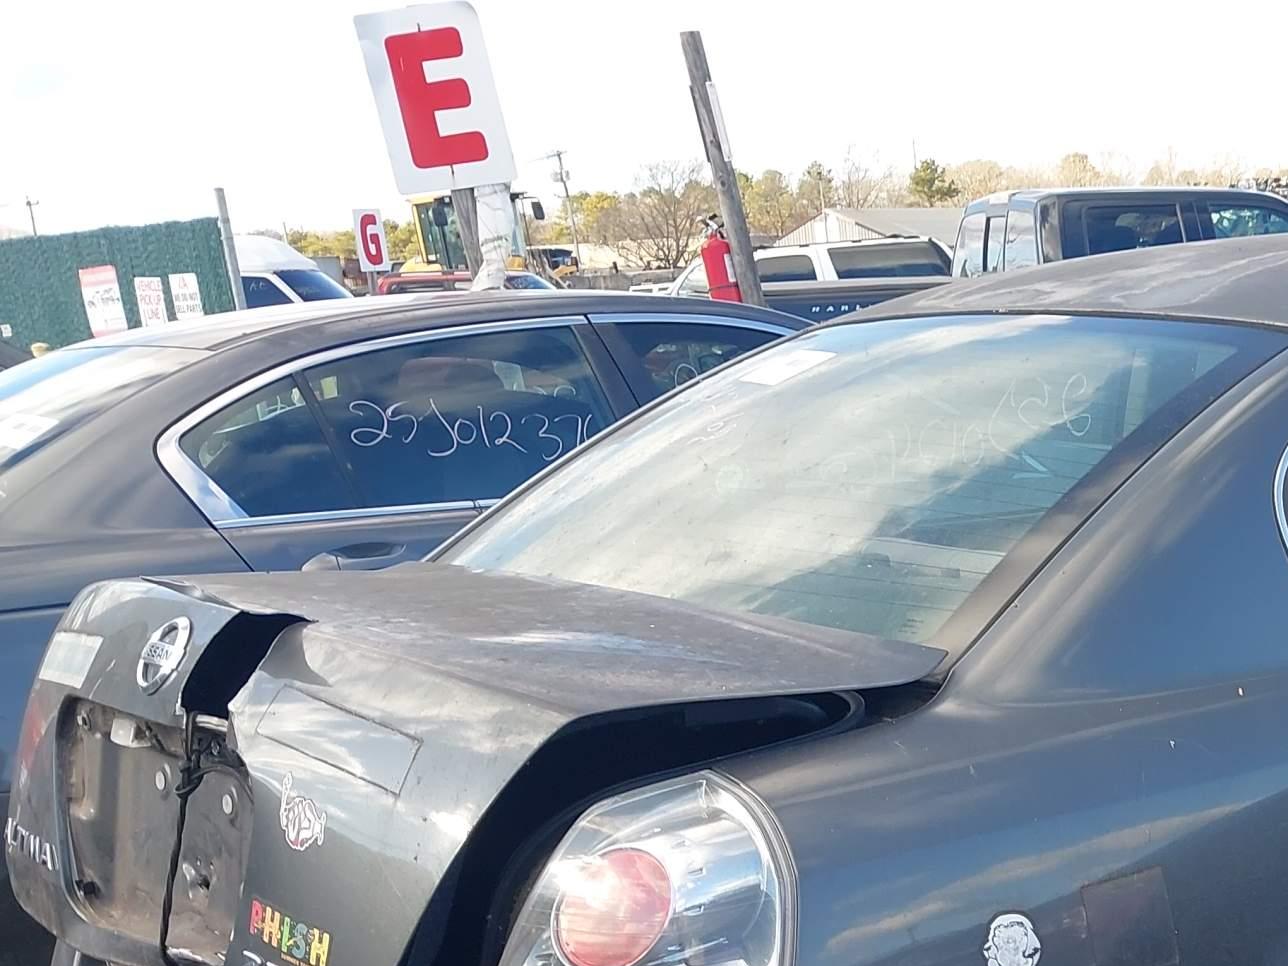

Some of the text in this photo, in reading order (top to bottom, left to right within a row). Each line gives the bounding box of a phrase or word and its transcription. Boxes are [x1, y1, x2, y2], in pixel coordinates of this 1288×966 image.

[384, 27, 489, 169] E
[360, 214, 384, 266] G
[811, 304, 873, 314] HARL
